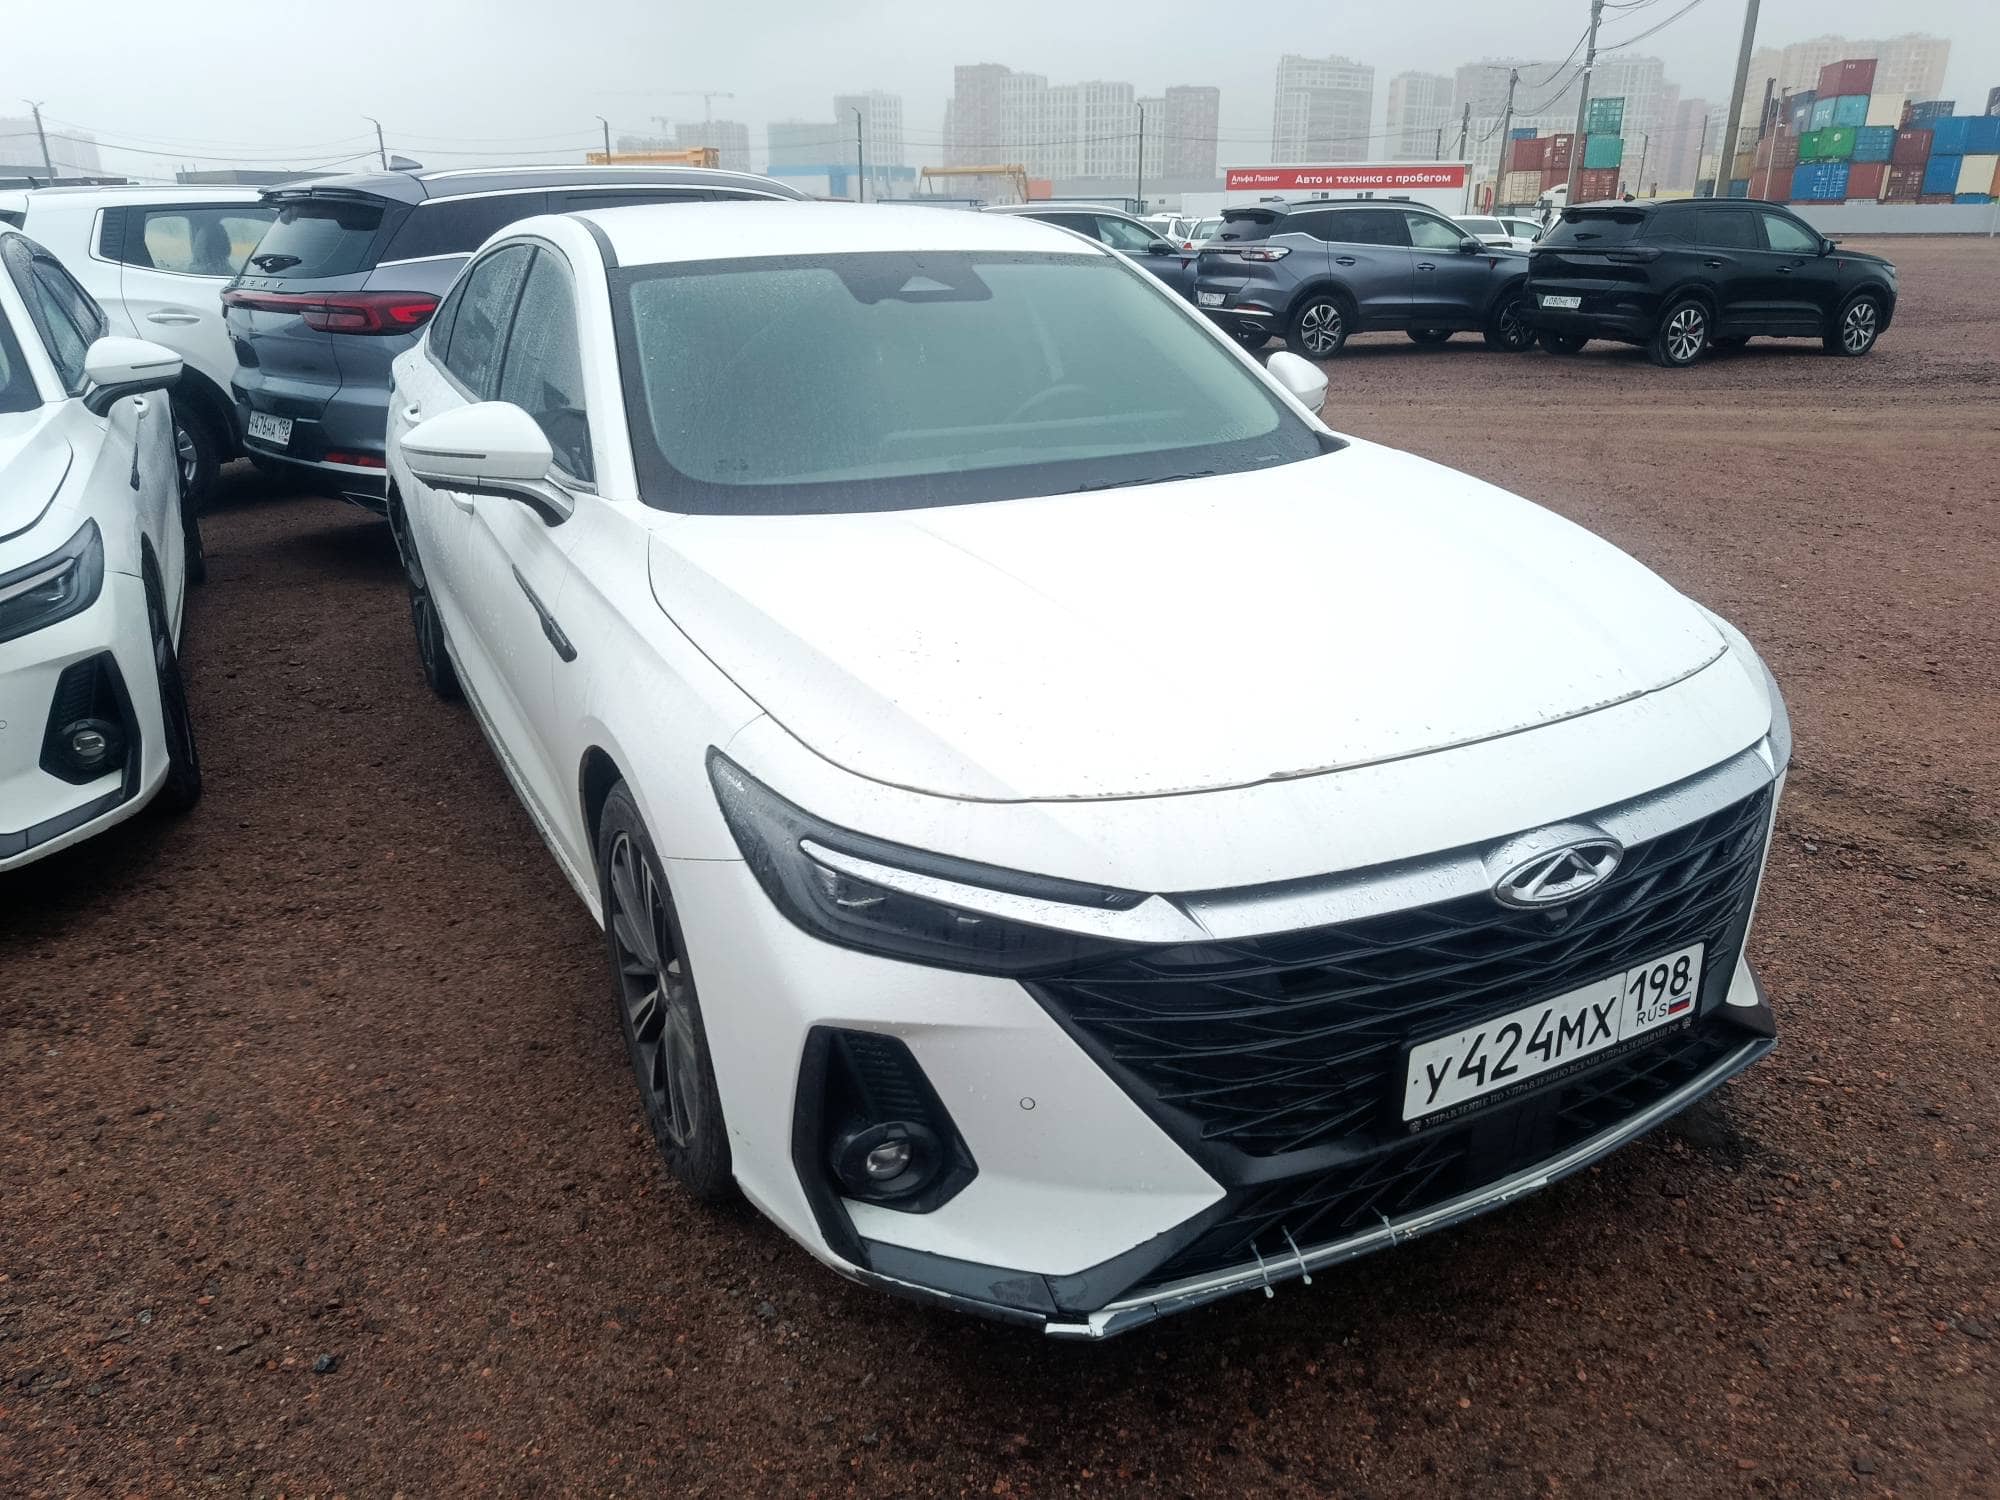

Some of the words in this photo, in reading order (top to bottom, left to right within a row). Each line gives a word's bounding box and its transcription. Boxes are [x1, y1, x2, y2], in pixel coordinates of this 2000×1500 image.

[1231, 174, 1254, 184] Альфа
[1254, 174, 1280, 183] Лизинг
[1295, 175, 1322, 184] Авто
[1336, 175, 1383, 184] техника
[1386, 175, 1393, 183] с
[1397, 173, 1452, 184] пробегом
[279, 418, 290, 436] 198
[1635, 1003, 1667, 1027] RUS
[1426, 996, 1617, 1105] У424МХ
[1629, 955, 1691, 1012] 198
